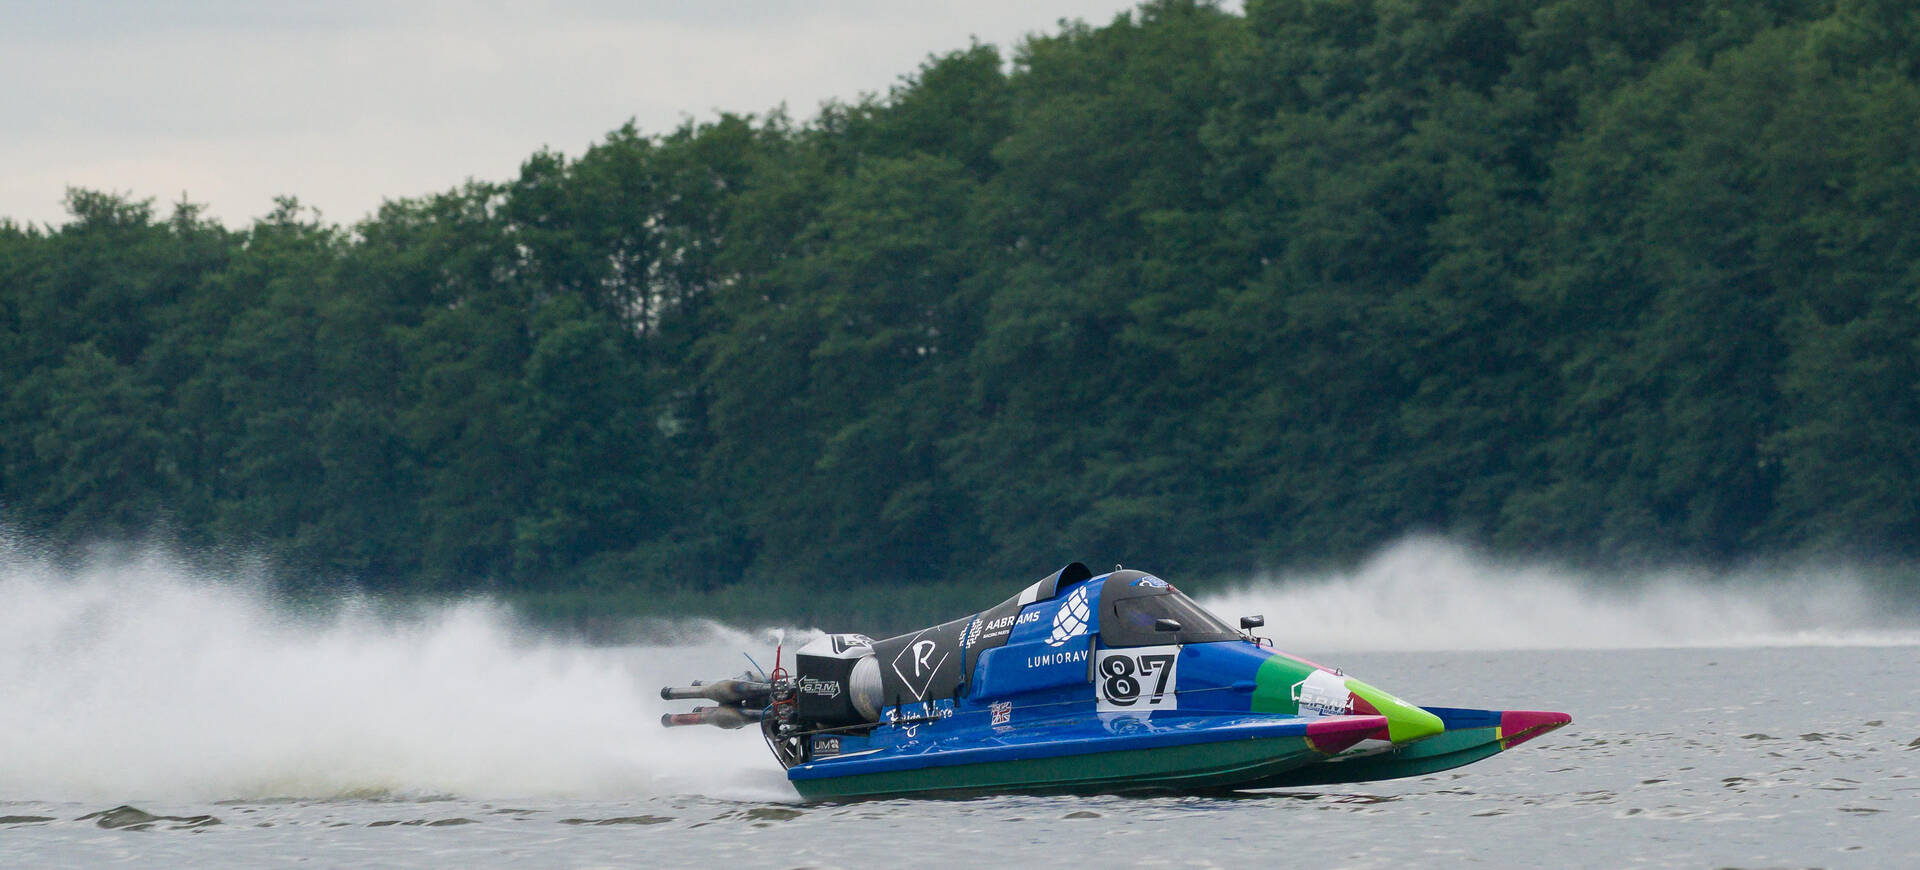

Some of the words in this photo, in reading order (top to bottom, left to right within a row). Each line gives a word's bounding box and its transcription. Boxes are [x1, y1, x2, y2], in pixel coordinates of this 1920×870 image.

[984, 611, 1041, 632] AABRAMS
[912, 640, 936, 677] R
[1027, 650, 1089, 669] LUMIORAV
[1100, 654, 1175, 706] 87
